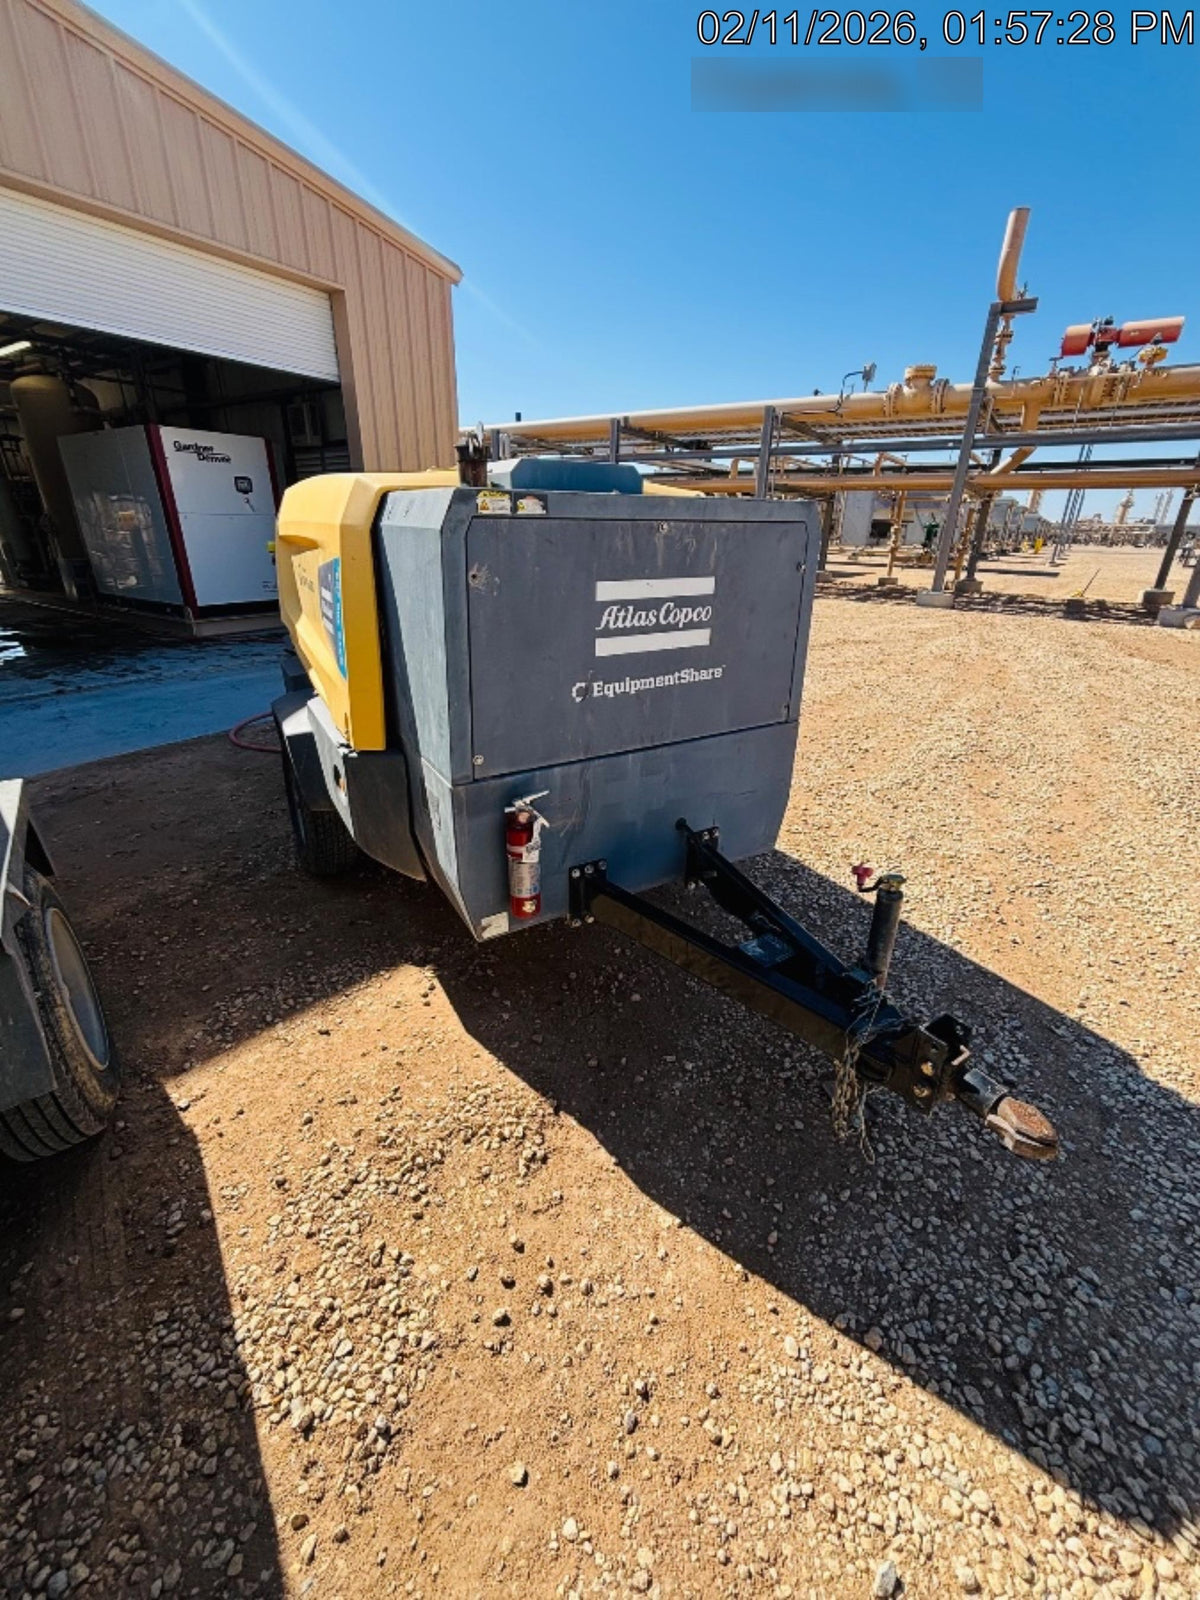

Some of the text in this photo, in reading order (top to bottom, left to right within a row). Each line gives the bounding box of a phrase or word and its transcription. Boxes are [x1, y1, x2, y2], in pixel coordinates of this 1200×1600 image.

[595, 601, 713, 630] Atlas Copco
[592, 667, 723, 698] EquipmentShare
